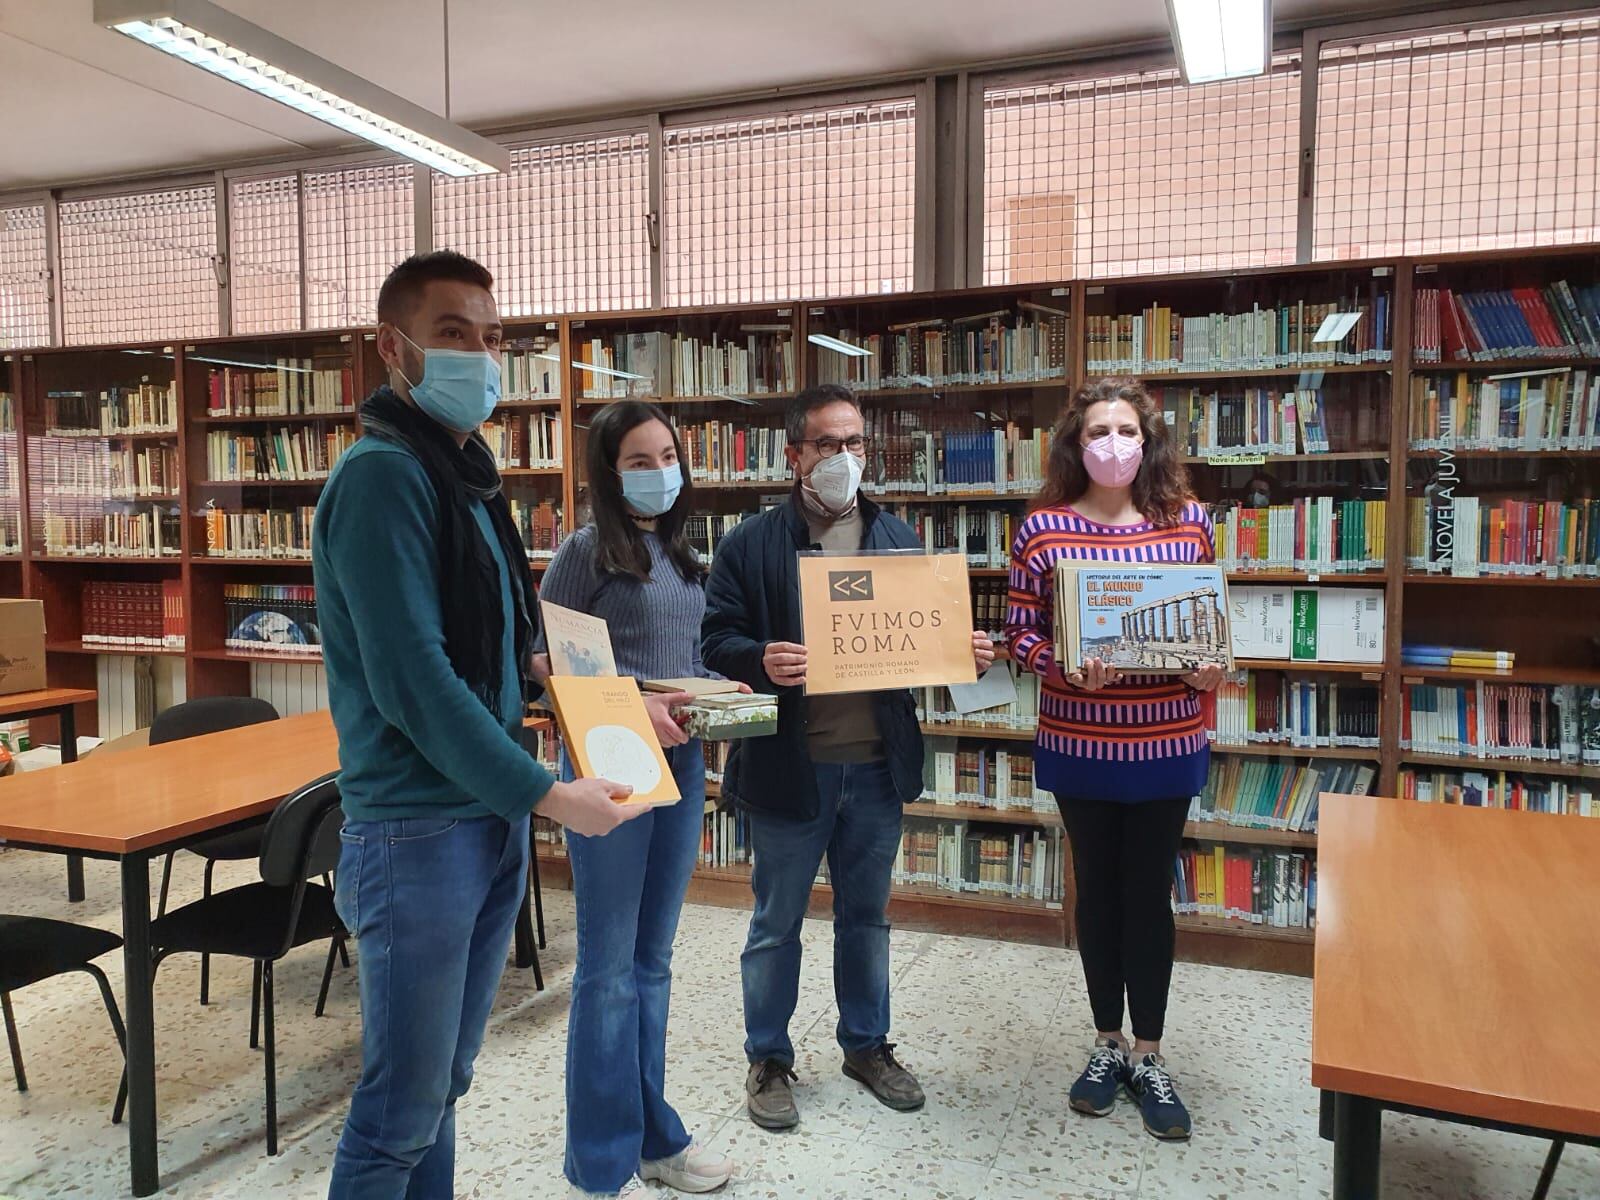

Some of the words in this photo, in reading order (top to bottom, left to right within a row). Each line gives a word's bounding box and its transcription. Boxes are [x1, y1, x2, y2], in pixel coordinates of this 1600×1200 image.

[1209, 456, 1233, 464] Novela
[1236, 455, 1263, 463] Juvenil
[206, 498, 216, 551] NOVELA
[1436, 485, 1455, 562] NOVELA
[1086, 581, 1100, 592] EL
[1103, 581, 1144, 592] MUNDO
[1087, 592, 1134, 607] CLÁSICO
[1297, 595, 1307, 628] NAVIGATOR
[831, 610, 942, 632] FVIMOS
[833, 634, 917, 655] ROMA
[1369, 640, 1377, 649] 80
[834, 662, 884, 671] PATRIMONIO
[885, 659, 920, 668] ROMANO
[848, 670, 885, 678] CASTILLA
[894, 667, 915, 675] LEÓN
